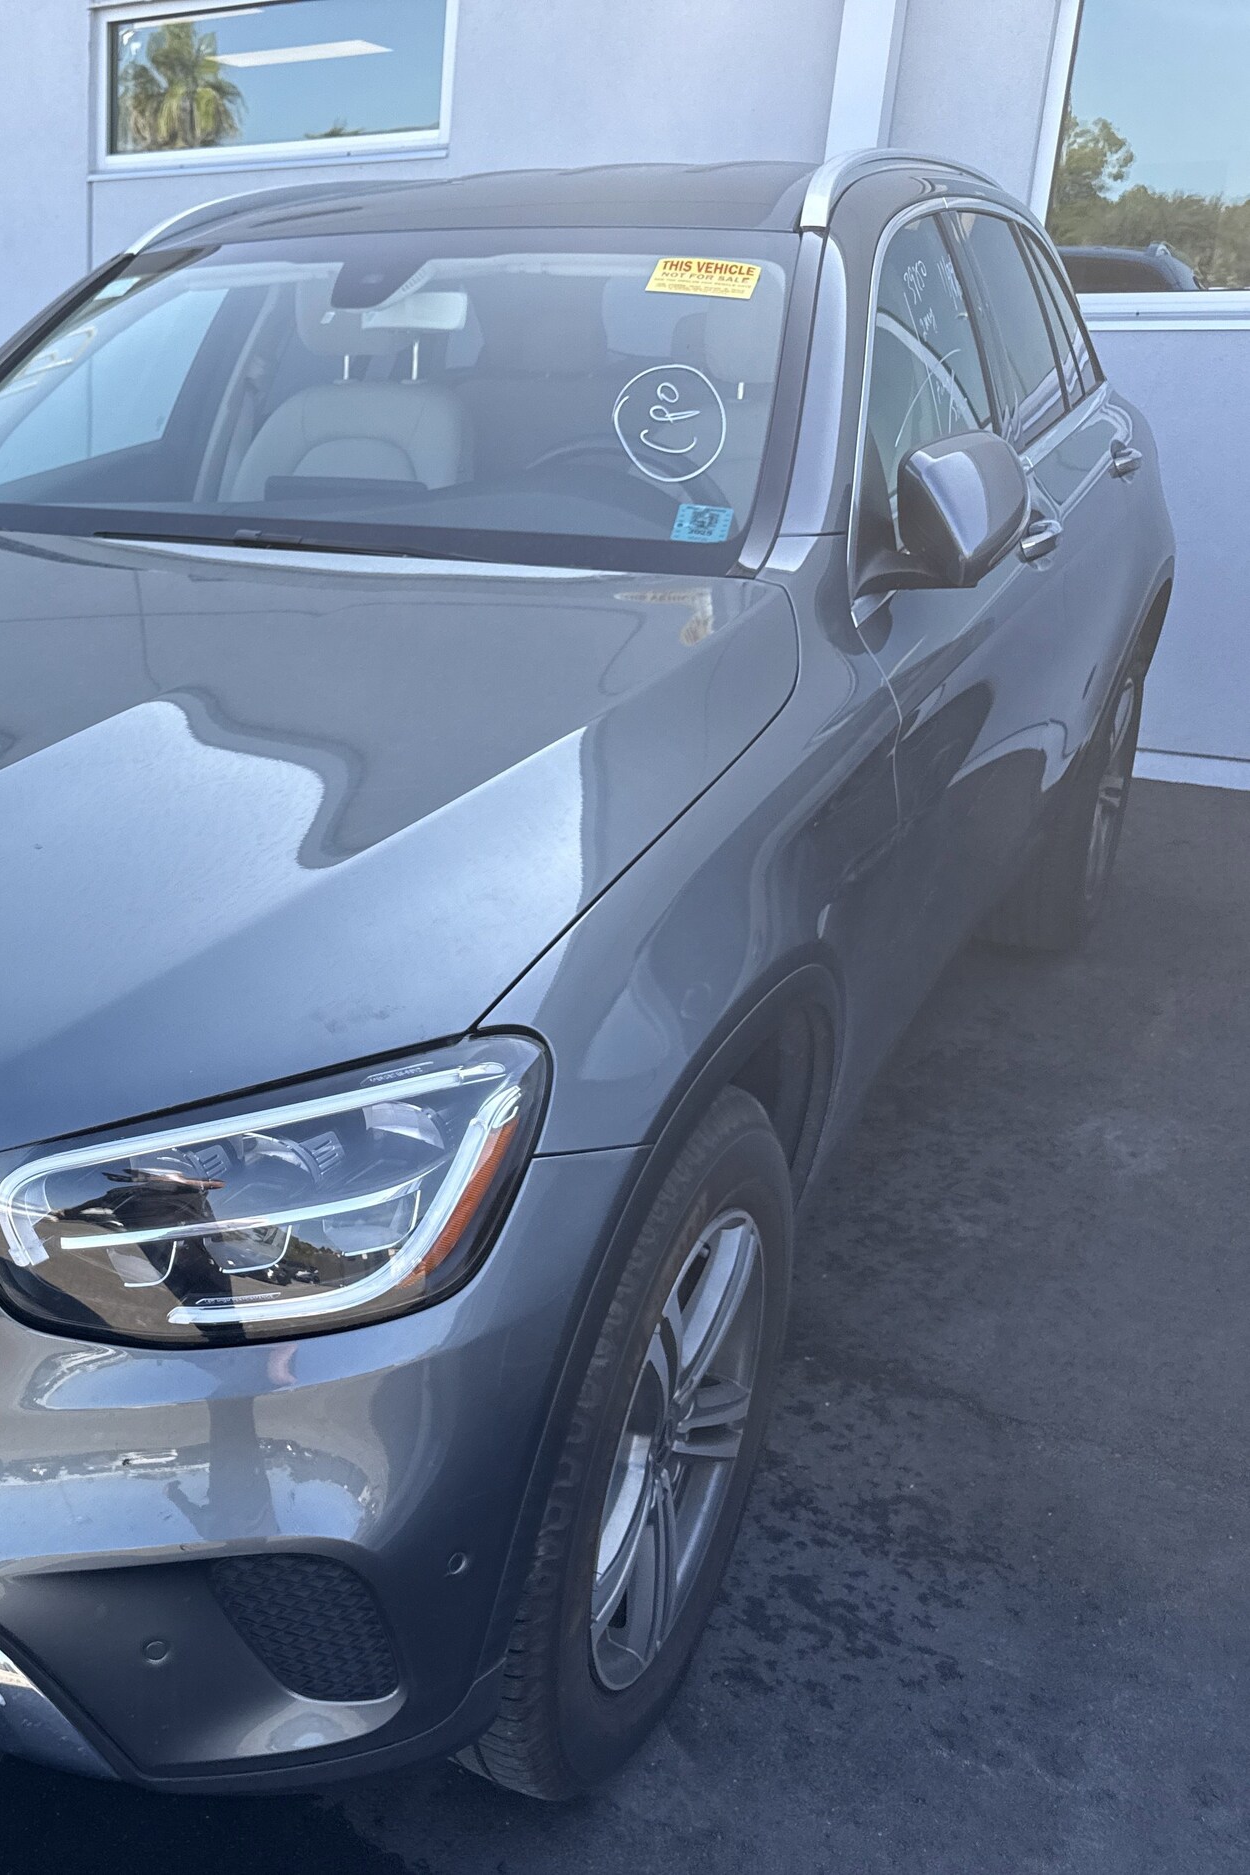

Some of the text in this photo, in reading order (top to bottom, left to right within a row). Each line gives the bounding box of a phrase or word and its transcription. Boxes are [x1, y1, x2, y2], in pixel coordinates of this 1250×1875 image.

[662, 260, 756, 277] THIS VEHICLE
[661, 271, 688, 279] NOT
[689, 272, 714, 281] FOR
[718, 275, 750, 284] SALE
